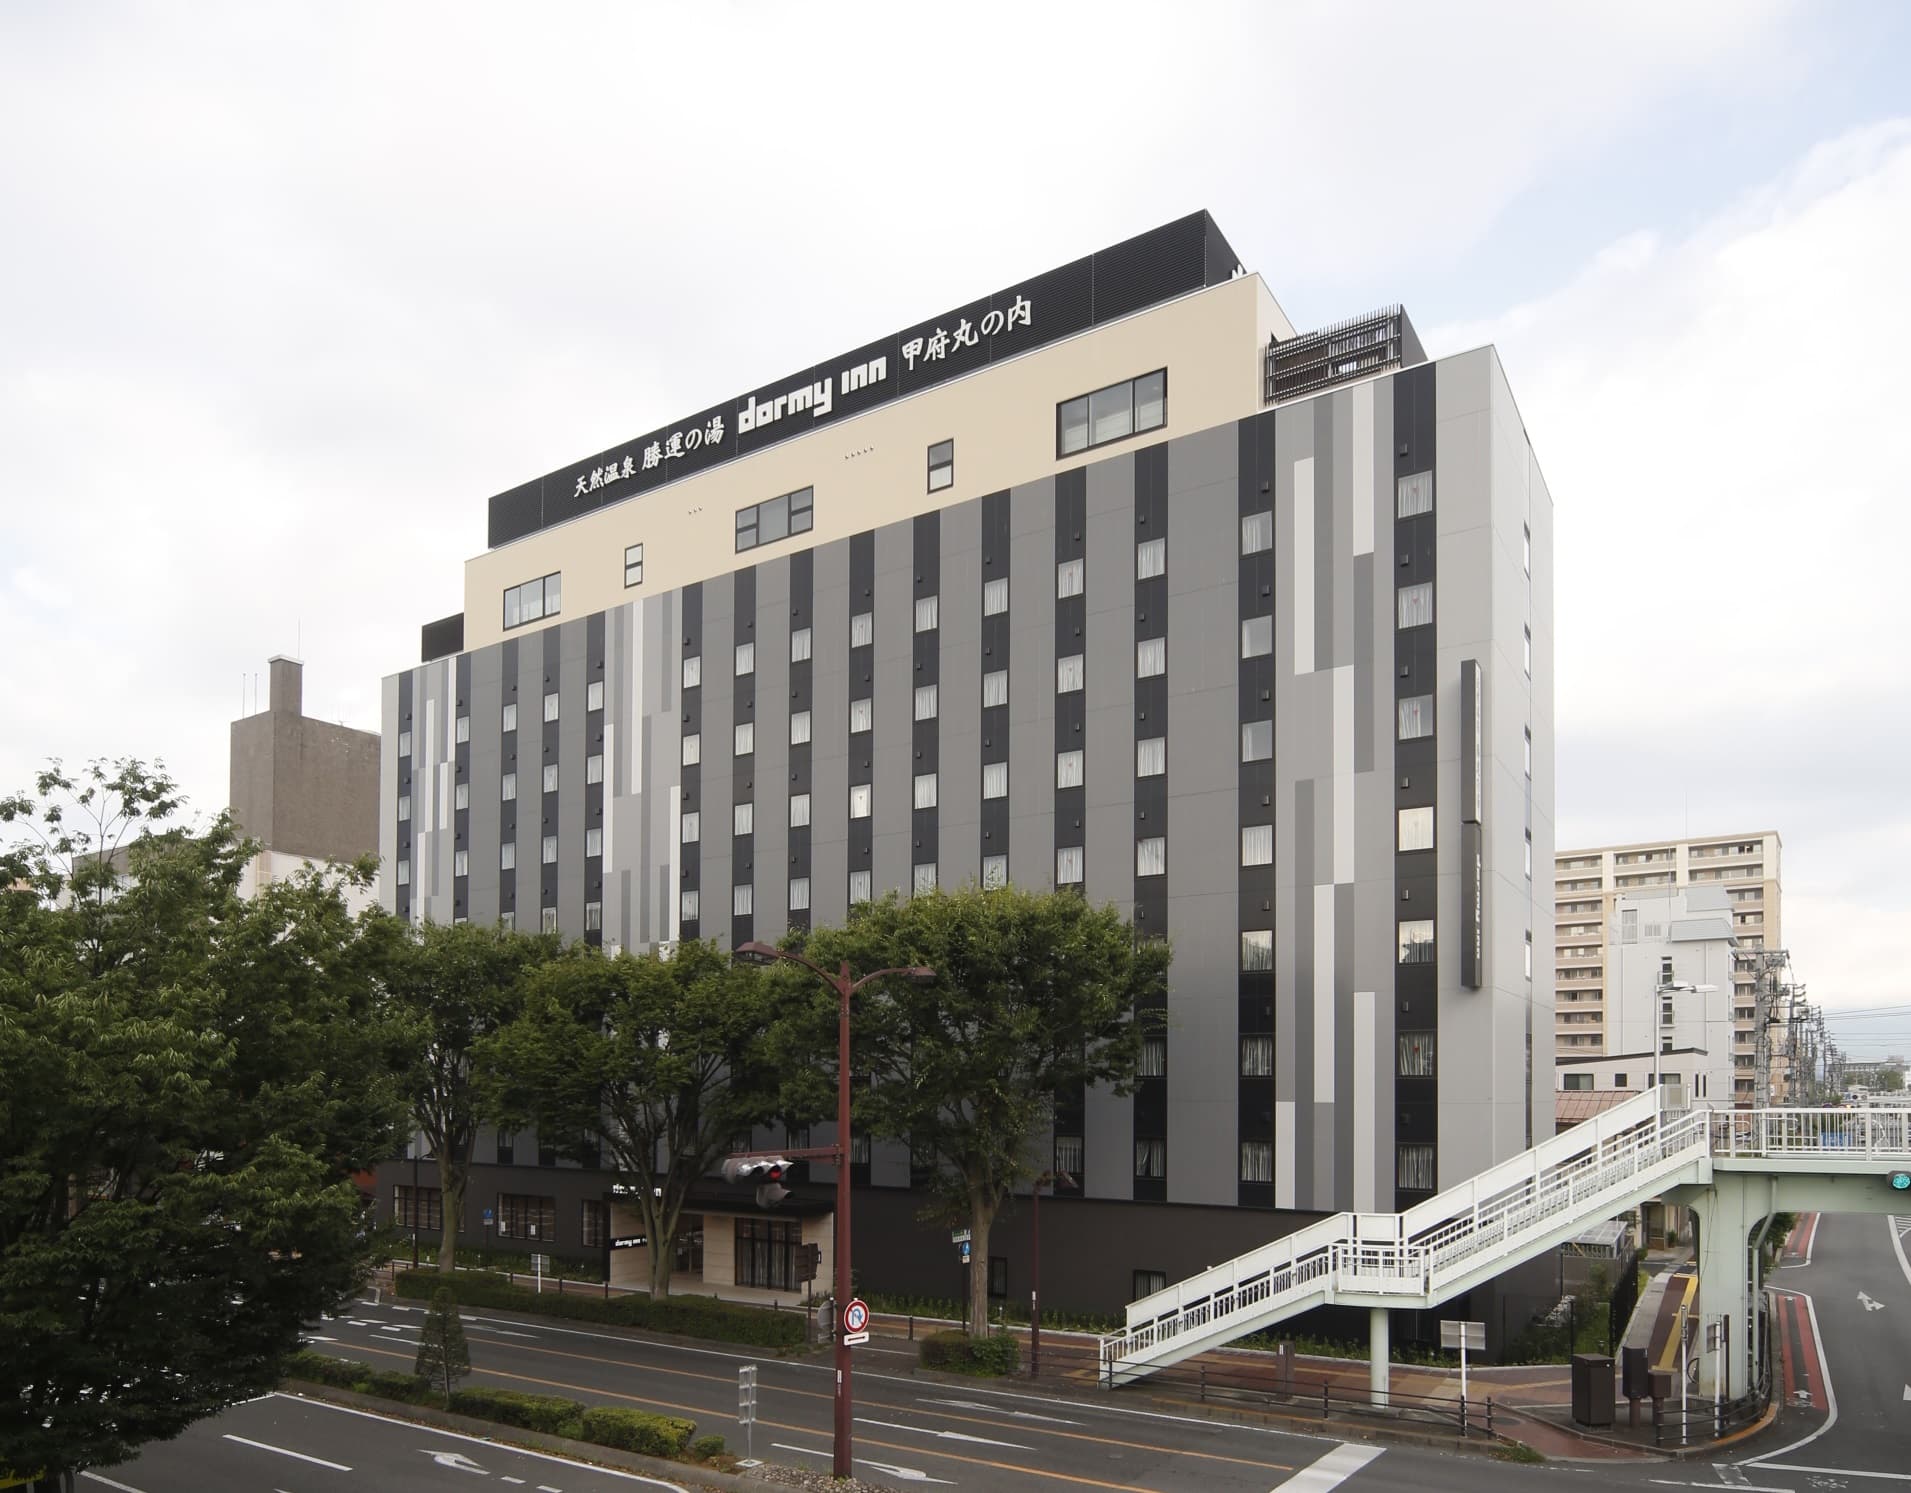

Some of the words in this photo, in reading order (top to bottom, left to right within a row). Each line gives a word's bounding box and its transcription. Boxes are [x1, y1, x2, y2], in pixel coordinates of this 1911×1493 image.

[574, 456, 637, 497] 天然温泉
[642, 416, 725, 470] 勝運の湯
[738, 377, 833, 434] dormy
[841, 356, 887, 395] inn
[902, 295, 1032, 371] 甲府丸の内
